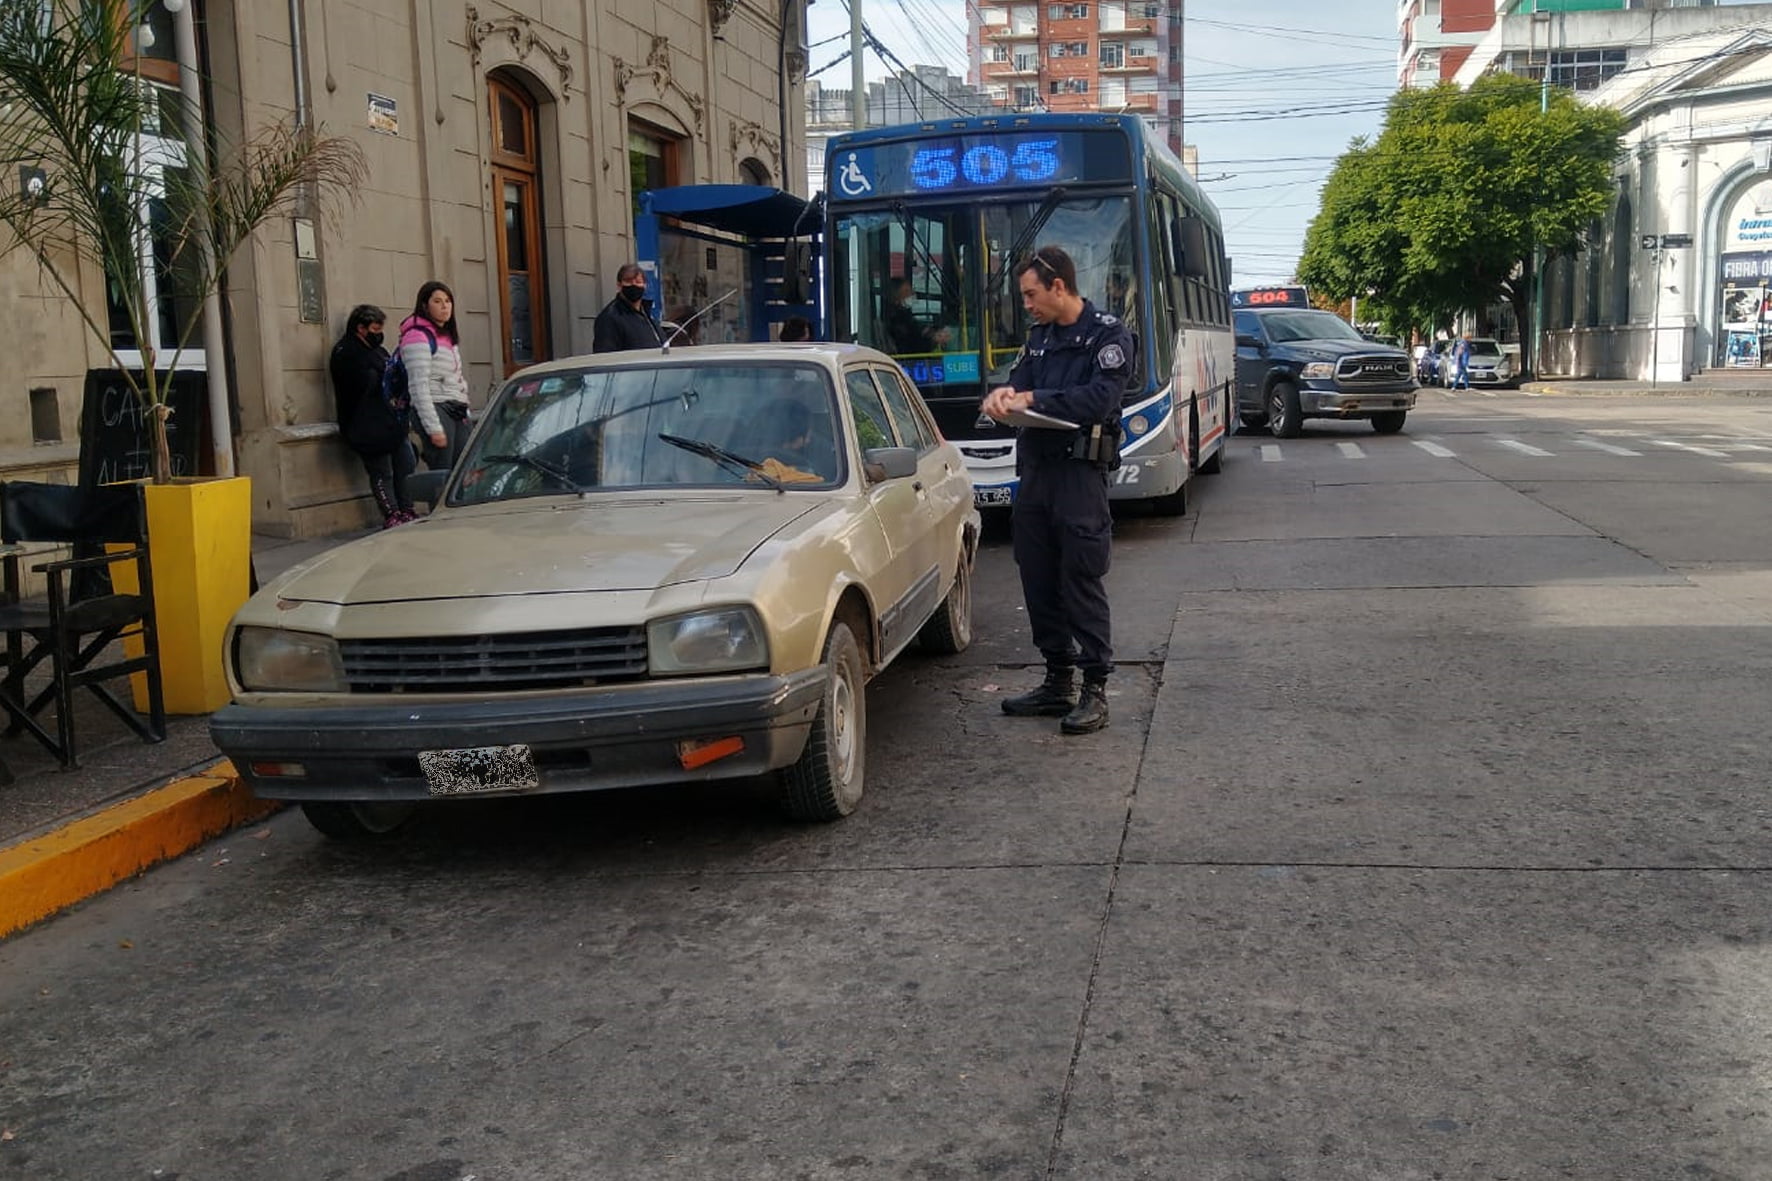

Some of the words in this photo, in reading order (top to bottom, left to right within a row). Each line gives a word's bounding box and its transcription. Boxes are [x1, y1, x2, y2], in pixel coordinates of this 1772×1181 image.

[911, 140, 1058, 188] 505
[1725, 261, 1758, 278] FIBRA
[1115, 464, 1141, 485] 72
